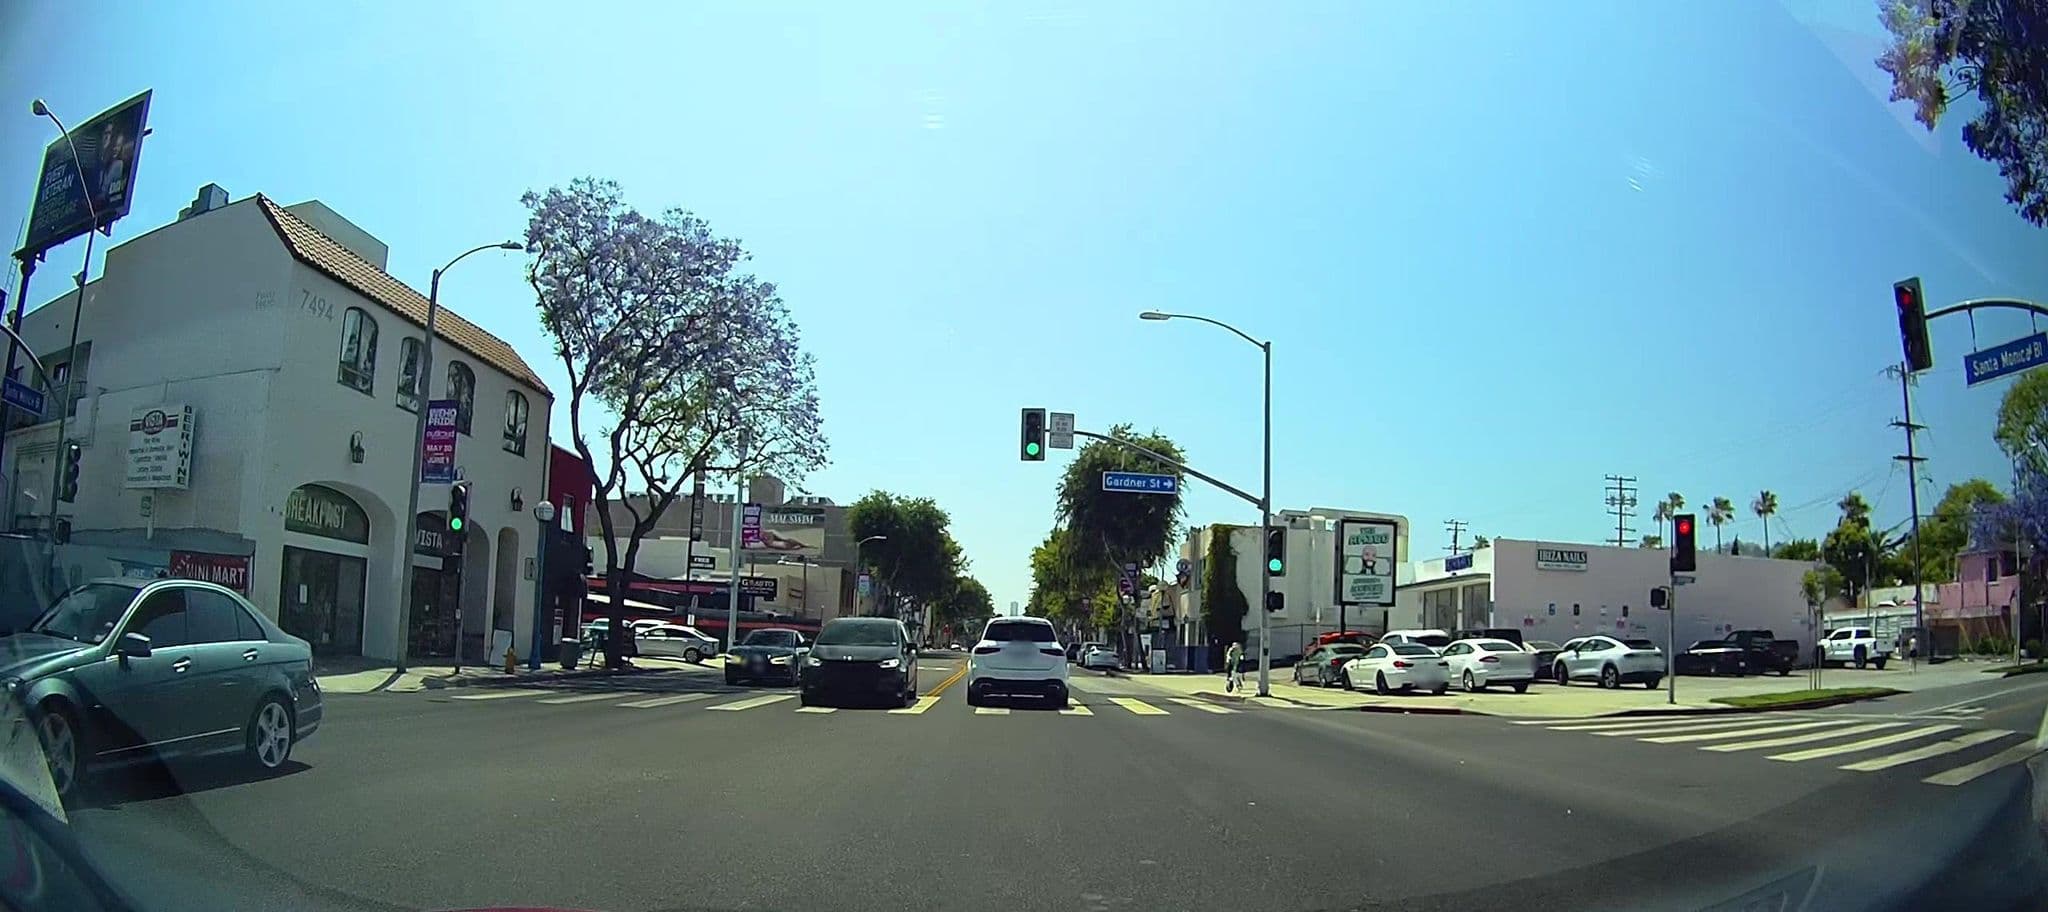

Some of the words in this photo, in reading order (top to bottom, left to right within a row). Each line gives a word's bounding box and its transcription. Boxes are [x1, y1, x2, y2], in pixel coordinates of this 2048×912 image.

[300, 288, 335, 322] 7494
[1972, 357, 1999, 377] Santa
[428, 417, 455, 426] PRIDE
[426, 444, 443, 453] MAY
[177, 449, 190, 486] WINE
[1106, 477, 1147, 488] Gardner
[1150, 478, 1161, 489] St
[285, 494, 348, 529] BREAKFAST
[1539, 550, 1562, 561] IBIZA
[1563, 551, 1586, 562] NAILS
[185, 563, 210, 581] MINI
[212, 565, 245, 585] MART
